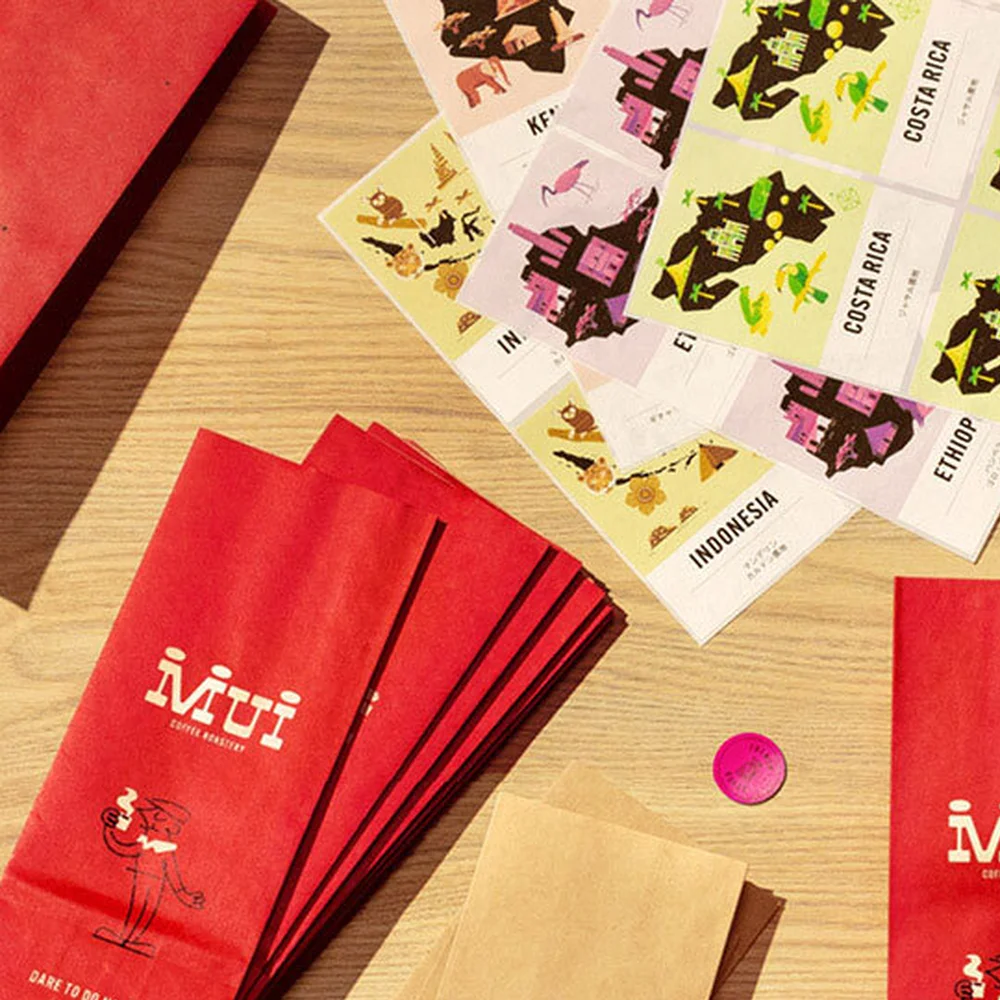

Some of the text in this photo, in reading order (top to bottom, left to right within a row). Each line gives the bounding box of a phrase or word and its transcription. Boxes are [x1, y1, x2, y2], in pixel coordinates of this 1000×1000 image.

[903, 38, 952, 143] COSTA RICA
[843, 229, 893, 334] COSTA RICA
[933, 416, 978, 482] ETHIOP
[689, 490, 779, 569] INDONESIA
[170, 718, 245, 753] COFFEE ROASTERY
[28, 970, 62, 993] DARE
[64, 983, 79, 998] TO
